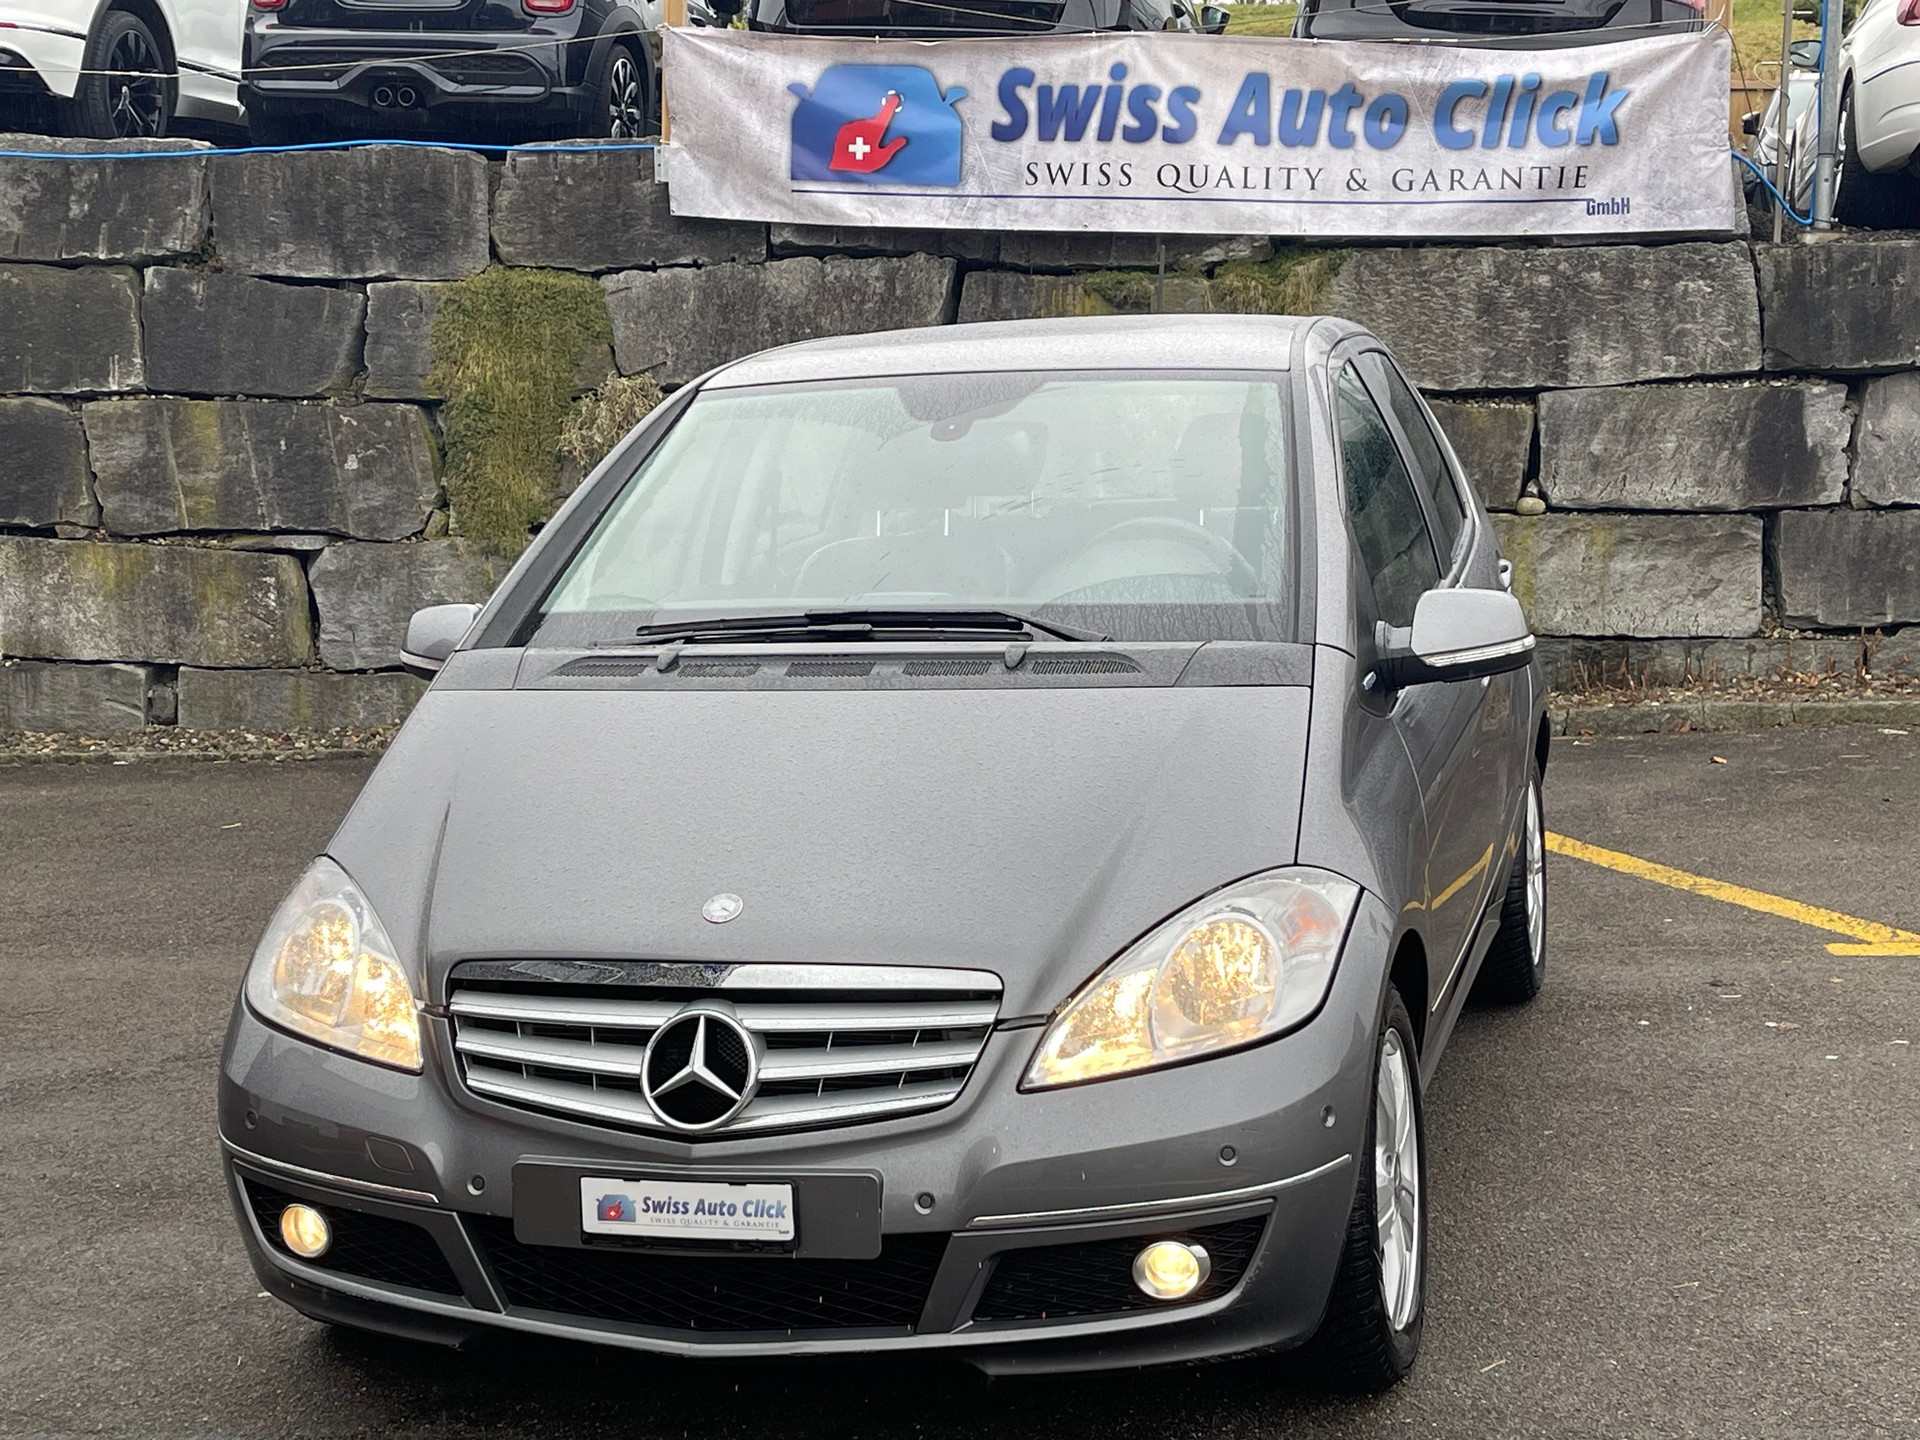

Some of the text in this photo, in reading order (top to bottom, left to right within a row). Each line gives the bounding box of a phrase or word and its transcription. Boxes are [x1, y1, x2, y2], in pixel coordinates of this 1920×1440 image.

[992, 62, 1631, 150] Swiss Auto Click
[1025, 162, 1589, 194] SWISS QUALITY & GARANTIE
[1585, 198, 1631, 217] GmbH
[642, 1196, 786, 1218] Swiss Auto Click
[650, 1217, 676, 1225] SWISS
[680, 1218, 718, 1227] QUALITY
[733, 1220, 779, 1228] GARANTIE
